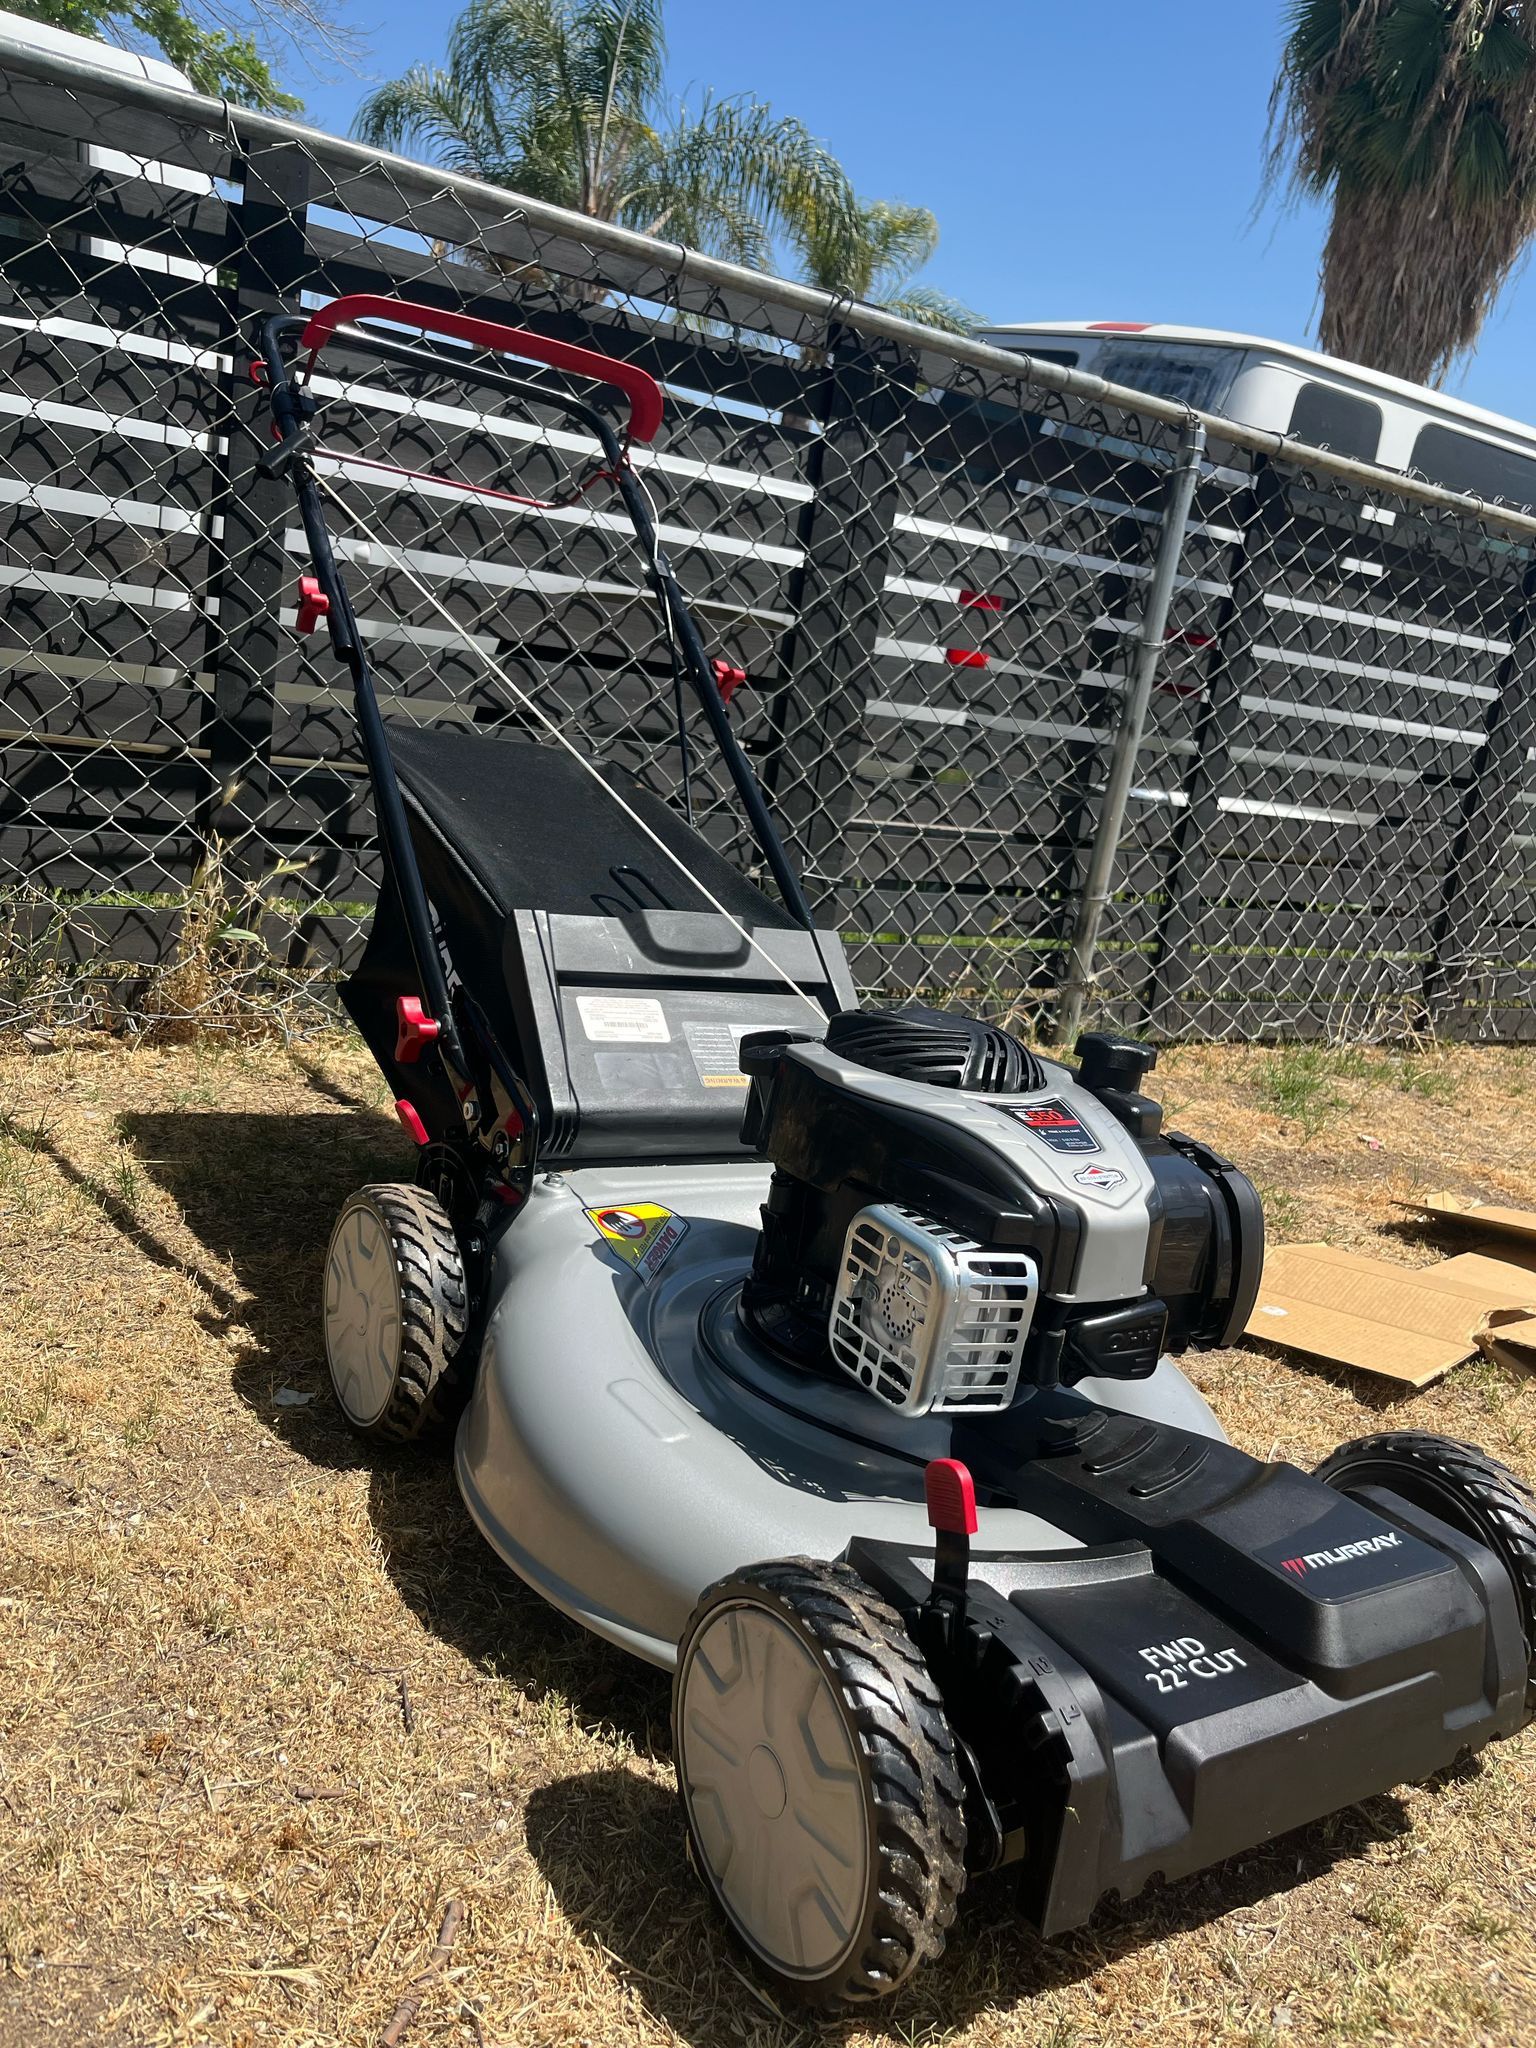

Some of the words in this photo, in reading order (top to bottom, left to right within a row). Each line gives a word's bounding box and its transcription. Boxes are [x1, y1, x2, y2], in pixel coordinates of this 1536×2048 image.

[1013, 1110, 1064, 1121] E550
[643, 1225, 679, 1272] DANGER
[1303, 1532, 1400, 1569] MURRAY
[1138, 1637, 1206, 1668] FWD
